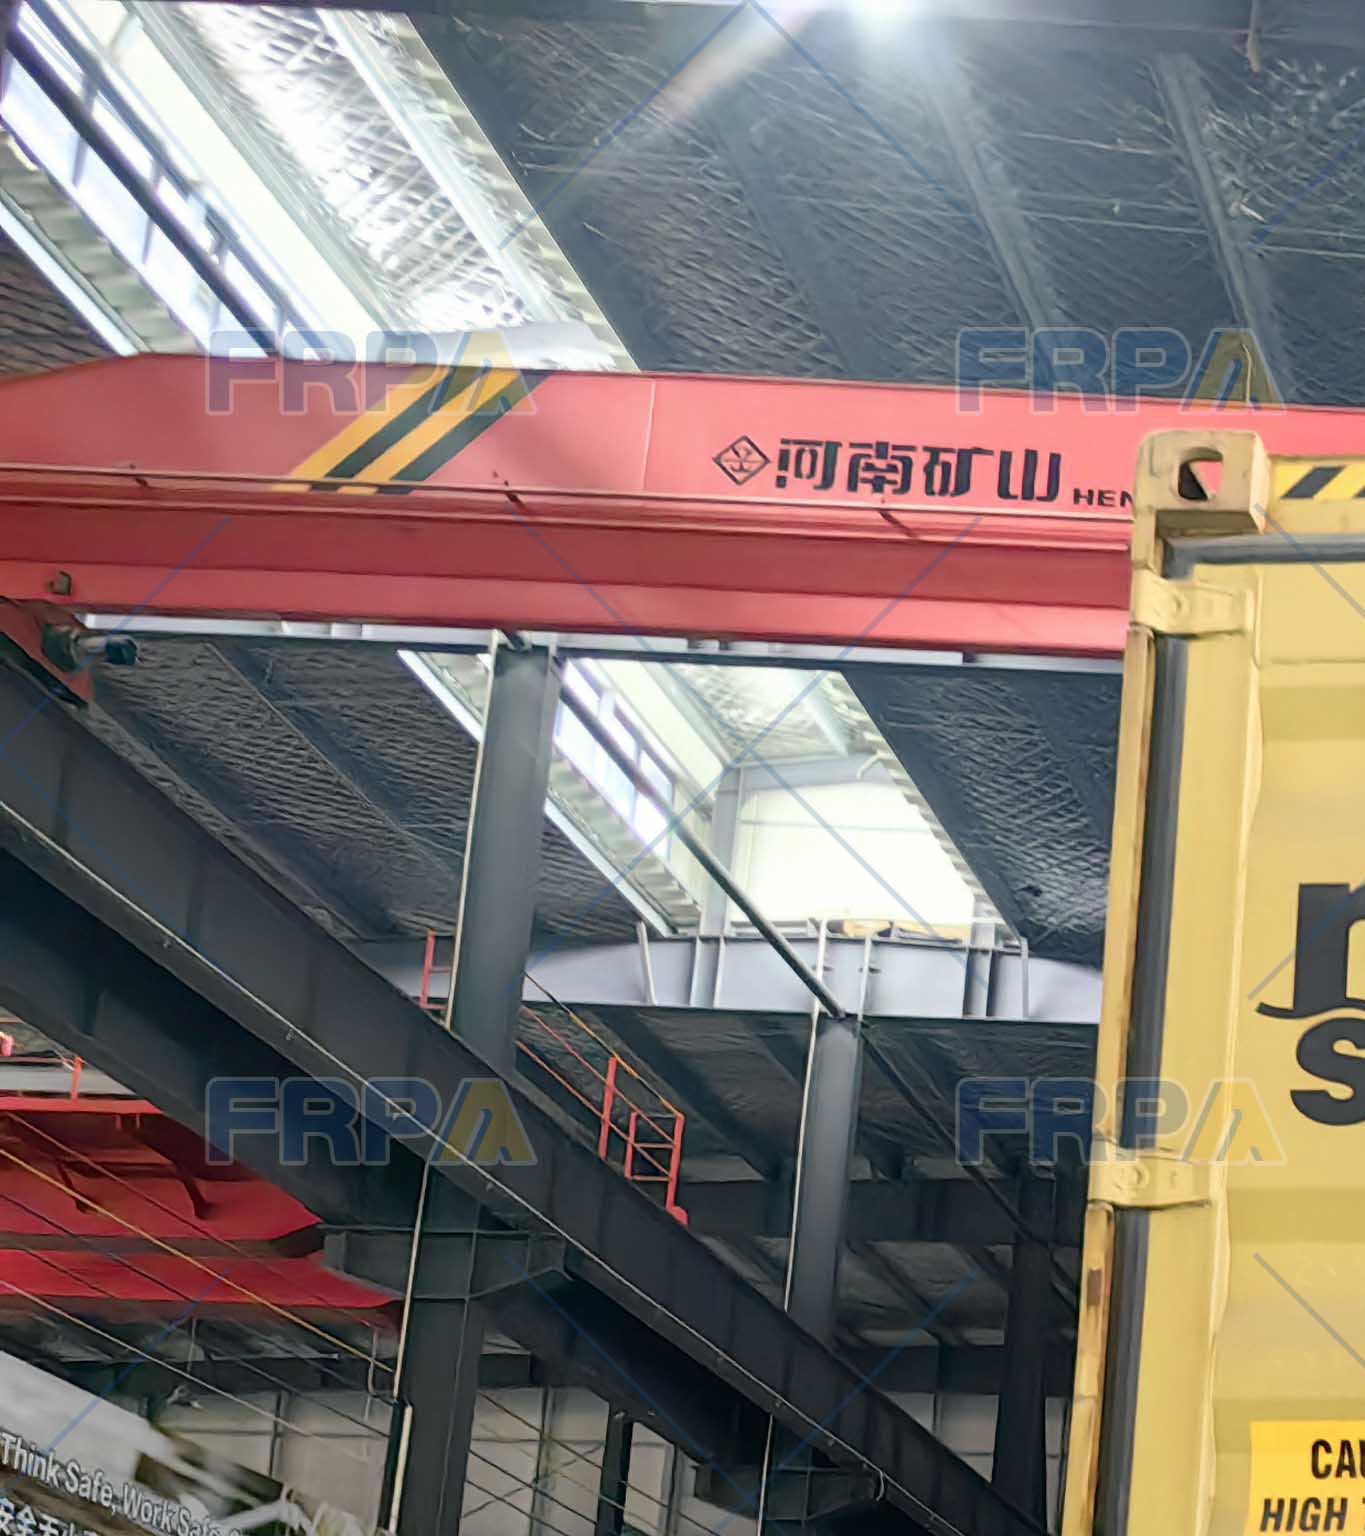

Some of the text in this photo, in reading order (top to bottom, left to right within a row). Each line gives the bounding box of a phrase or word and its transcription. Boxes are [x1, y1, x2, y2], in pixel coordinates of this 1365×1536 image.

[776, 438, 1062, 502] 河南矿山
[1, 1432, 61, 1486] Think
[121, 1482, 175, 1534] Work
[1259, 1498, 1348, 1532] HIGH
